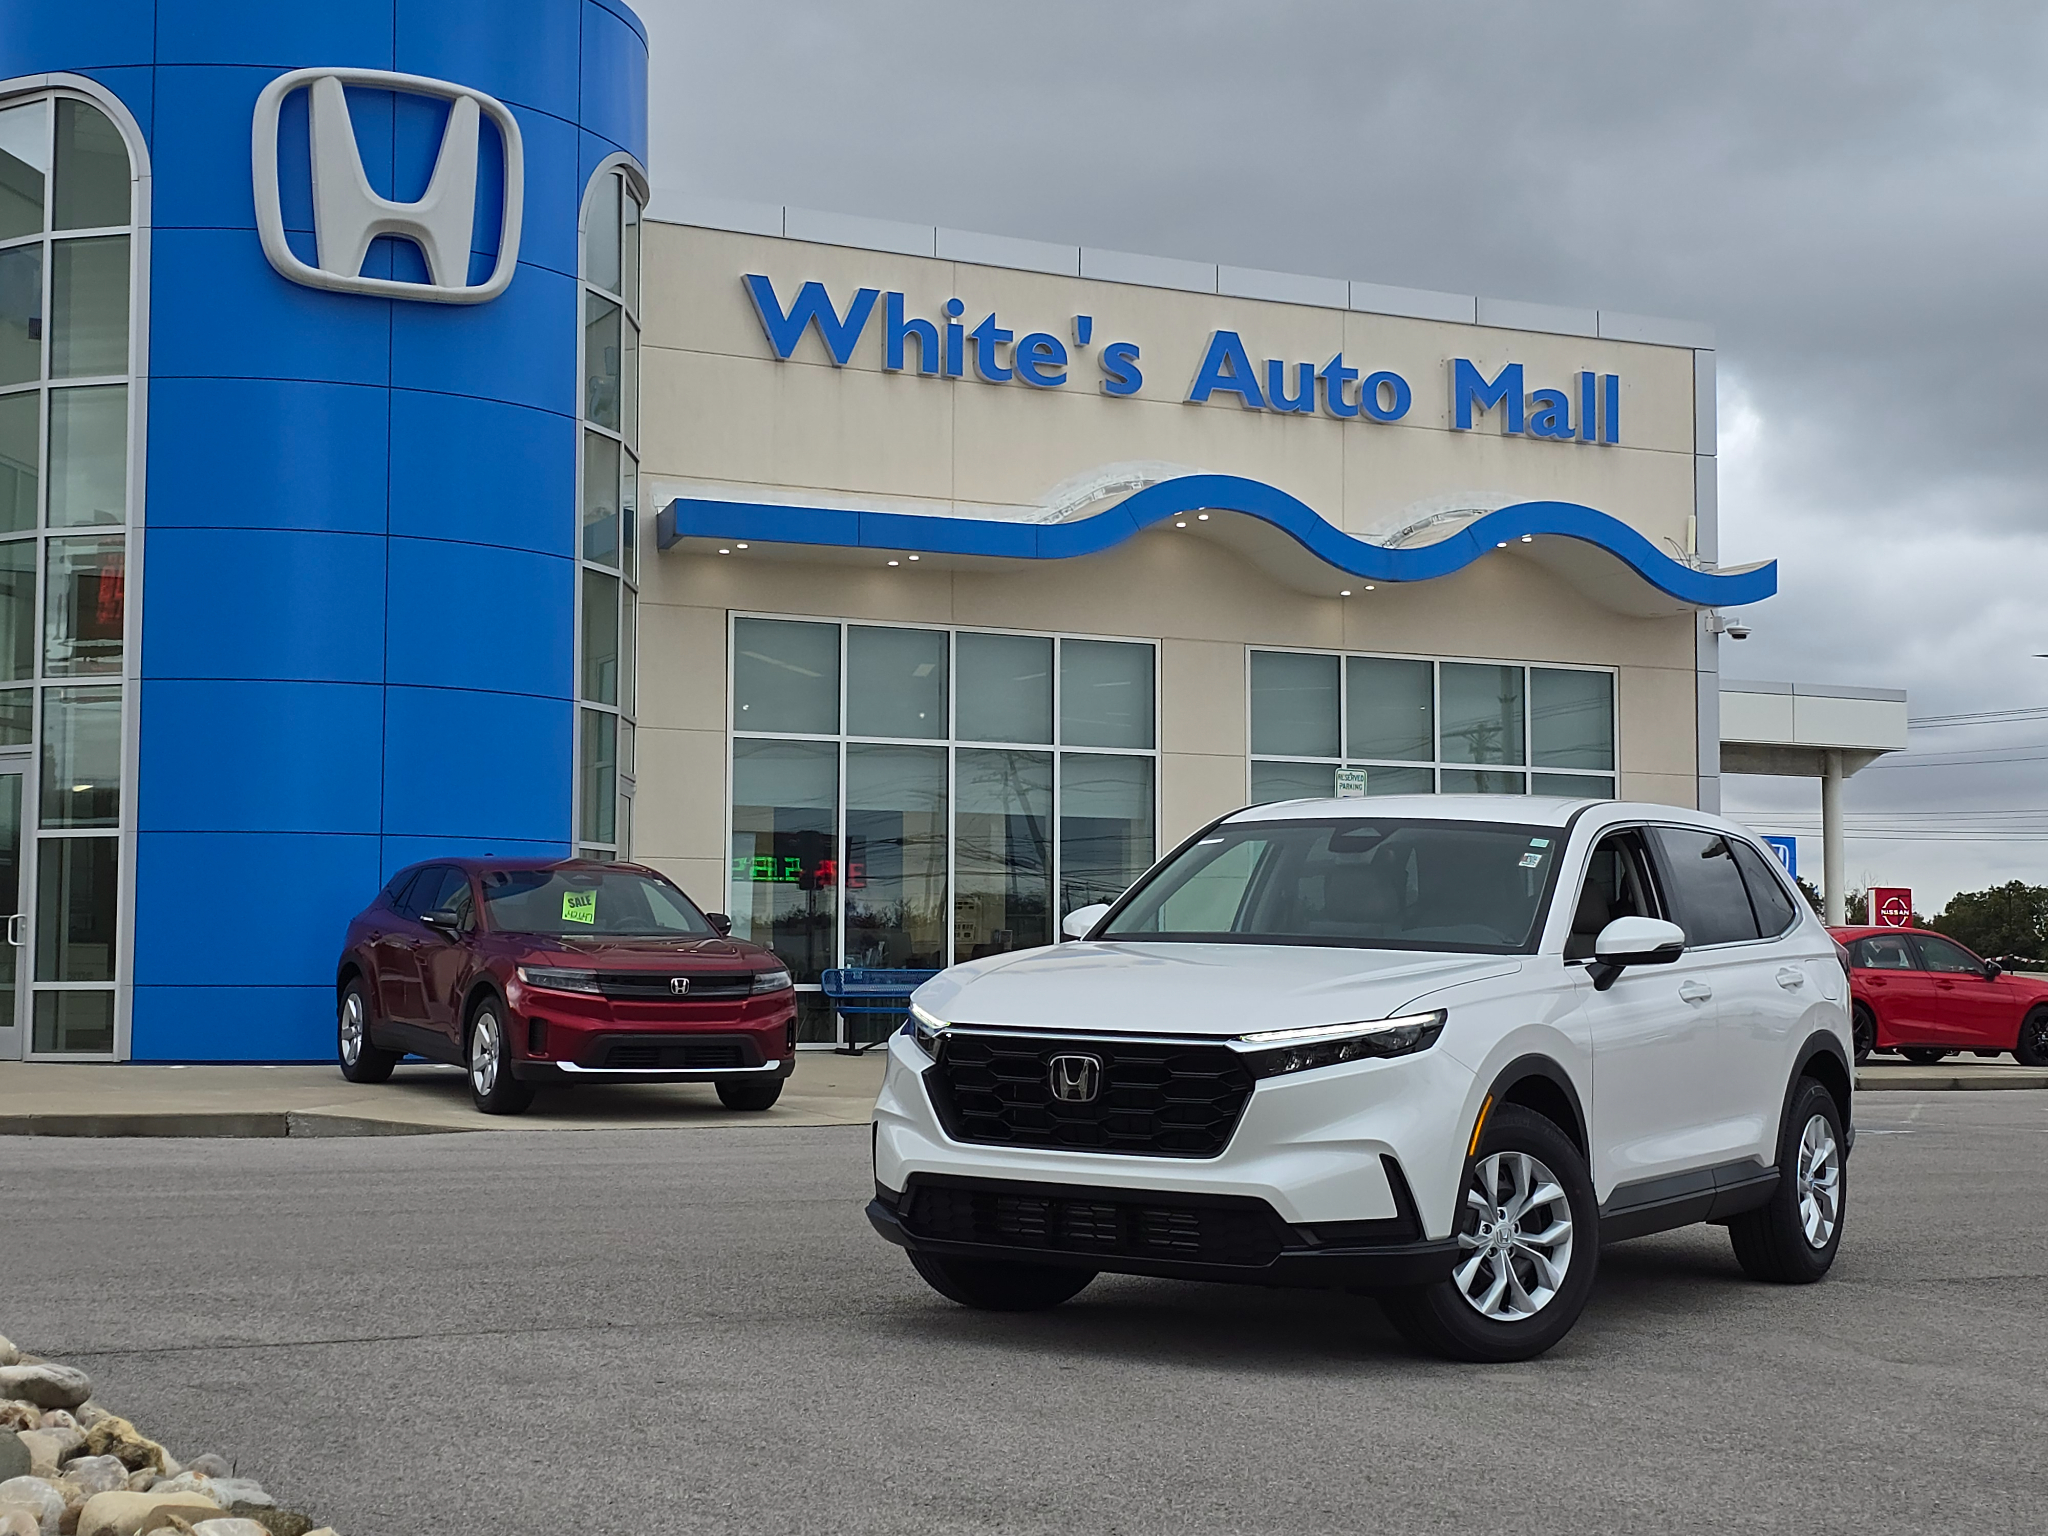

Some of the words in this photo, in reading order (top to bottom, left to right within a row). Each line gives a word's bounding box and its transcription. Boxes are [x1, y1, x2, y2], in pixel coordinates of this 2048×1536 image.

[741, 273, 1143, 398] White's
[1183, 329, 1412, 425] Auto
[1447, 357, 1619, 445] Mall
[1339, 783, 1363, 791] PARKING
[567, 895, 592, 908] SALE
